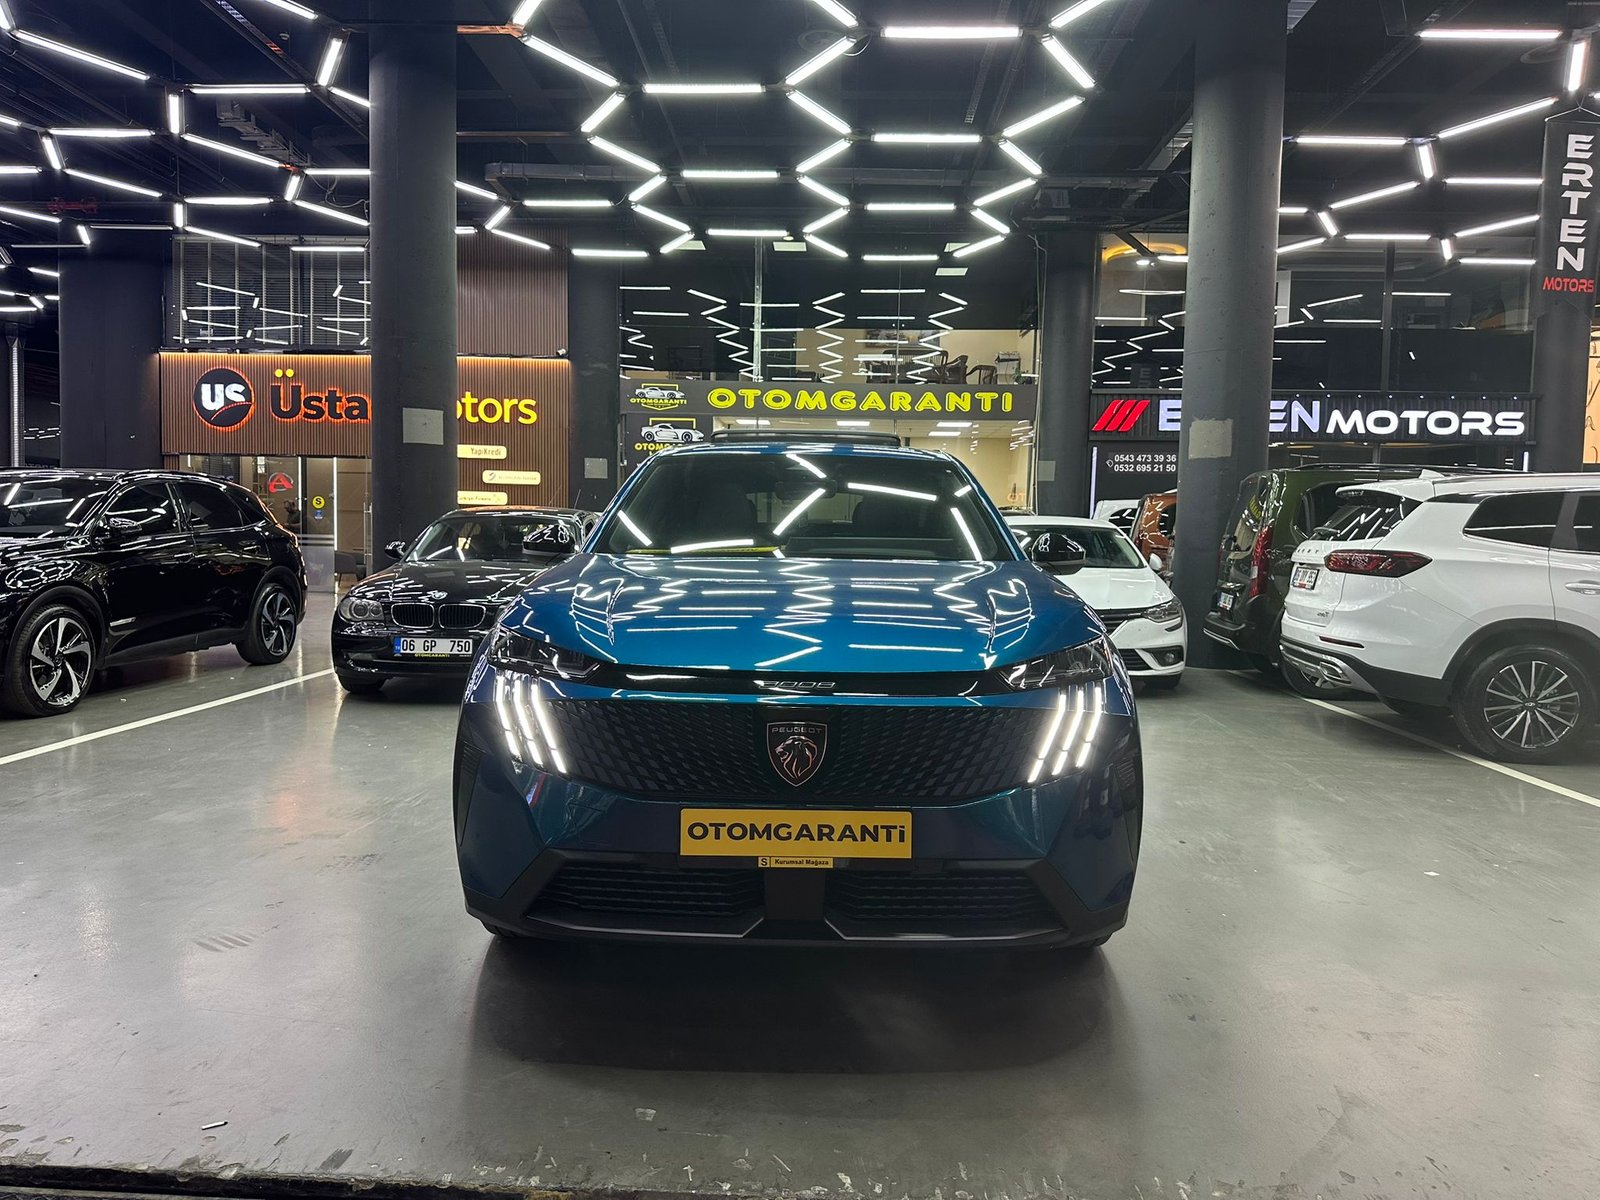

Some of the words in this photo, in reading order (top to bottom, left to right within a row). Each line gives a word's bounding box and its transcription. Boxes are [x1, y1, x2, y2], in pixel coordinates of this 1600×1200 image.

[1556, 133, 1595, 272] ERTEN
[1542, 276, 1595, 293] MOTORS
[629, 397, 688, 405] OTOMGARANTI
[707, 387, 1013, 413] OTOMGARANTI
[457, 391, 538, 425] tors
[1158, 399, 1321, 433] EEN
[1325, 409, 1525, 436] MOTORS
[1114, 454, 1135, 462] 0543
[1136, 454, 1152, 462] 473
[1153, 454, 1165, 462] 39
[1166, 454, 1177, 462] 36
[1113, 464, 1135, 472] 0532
[1136, 464, 1152, 472] 695
[1153, 464, 1163, 472] 21
[1165, 464, 1177, 472] 50
[401, 639, 415, 652] 06
[423, 640, 437, 652] GP
[449, 640, 471, 653] 750
[758, 680, 836, 690] 3008
[760, 858, 768, 866] S
